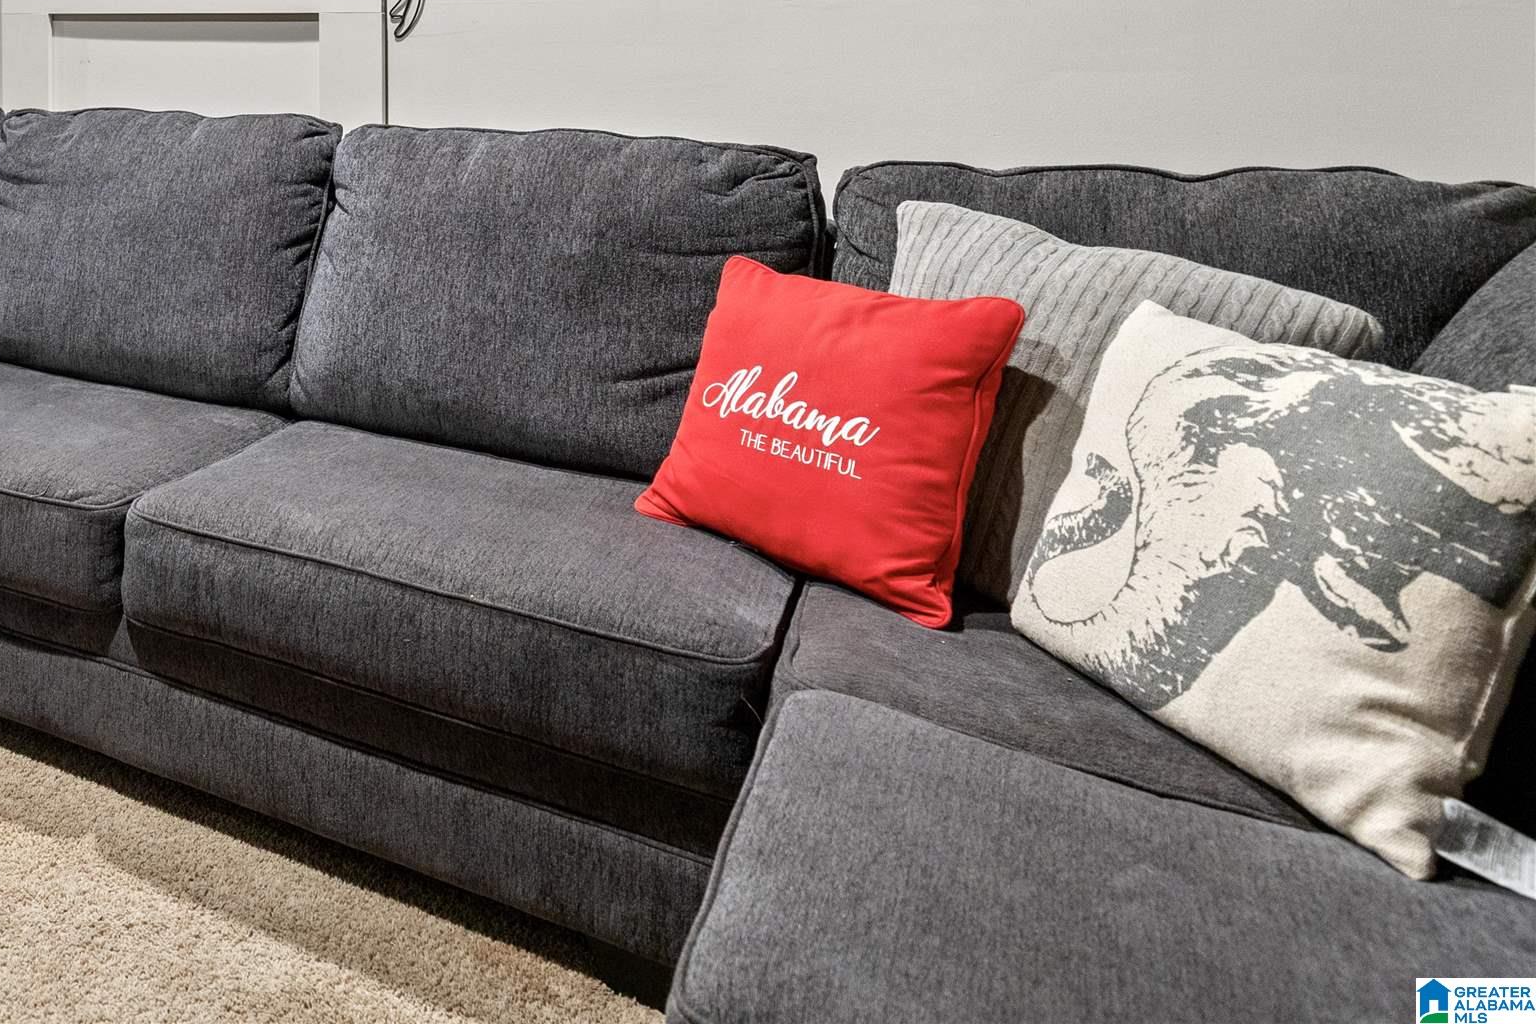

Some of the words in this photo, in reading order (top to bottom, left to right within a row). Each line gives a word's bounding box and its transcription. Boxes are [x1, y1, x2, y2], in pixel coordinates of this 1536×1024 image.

[702, 365, 880, 447] Alabama
[740, 428, 768, 452] THE
[770, 437, 862, 480] BEAUTIFUL
